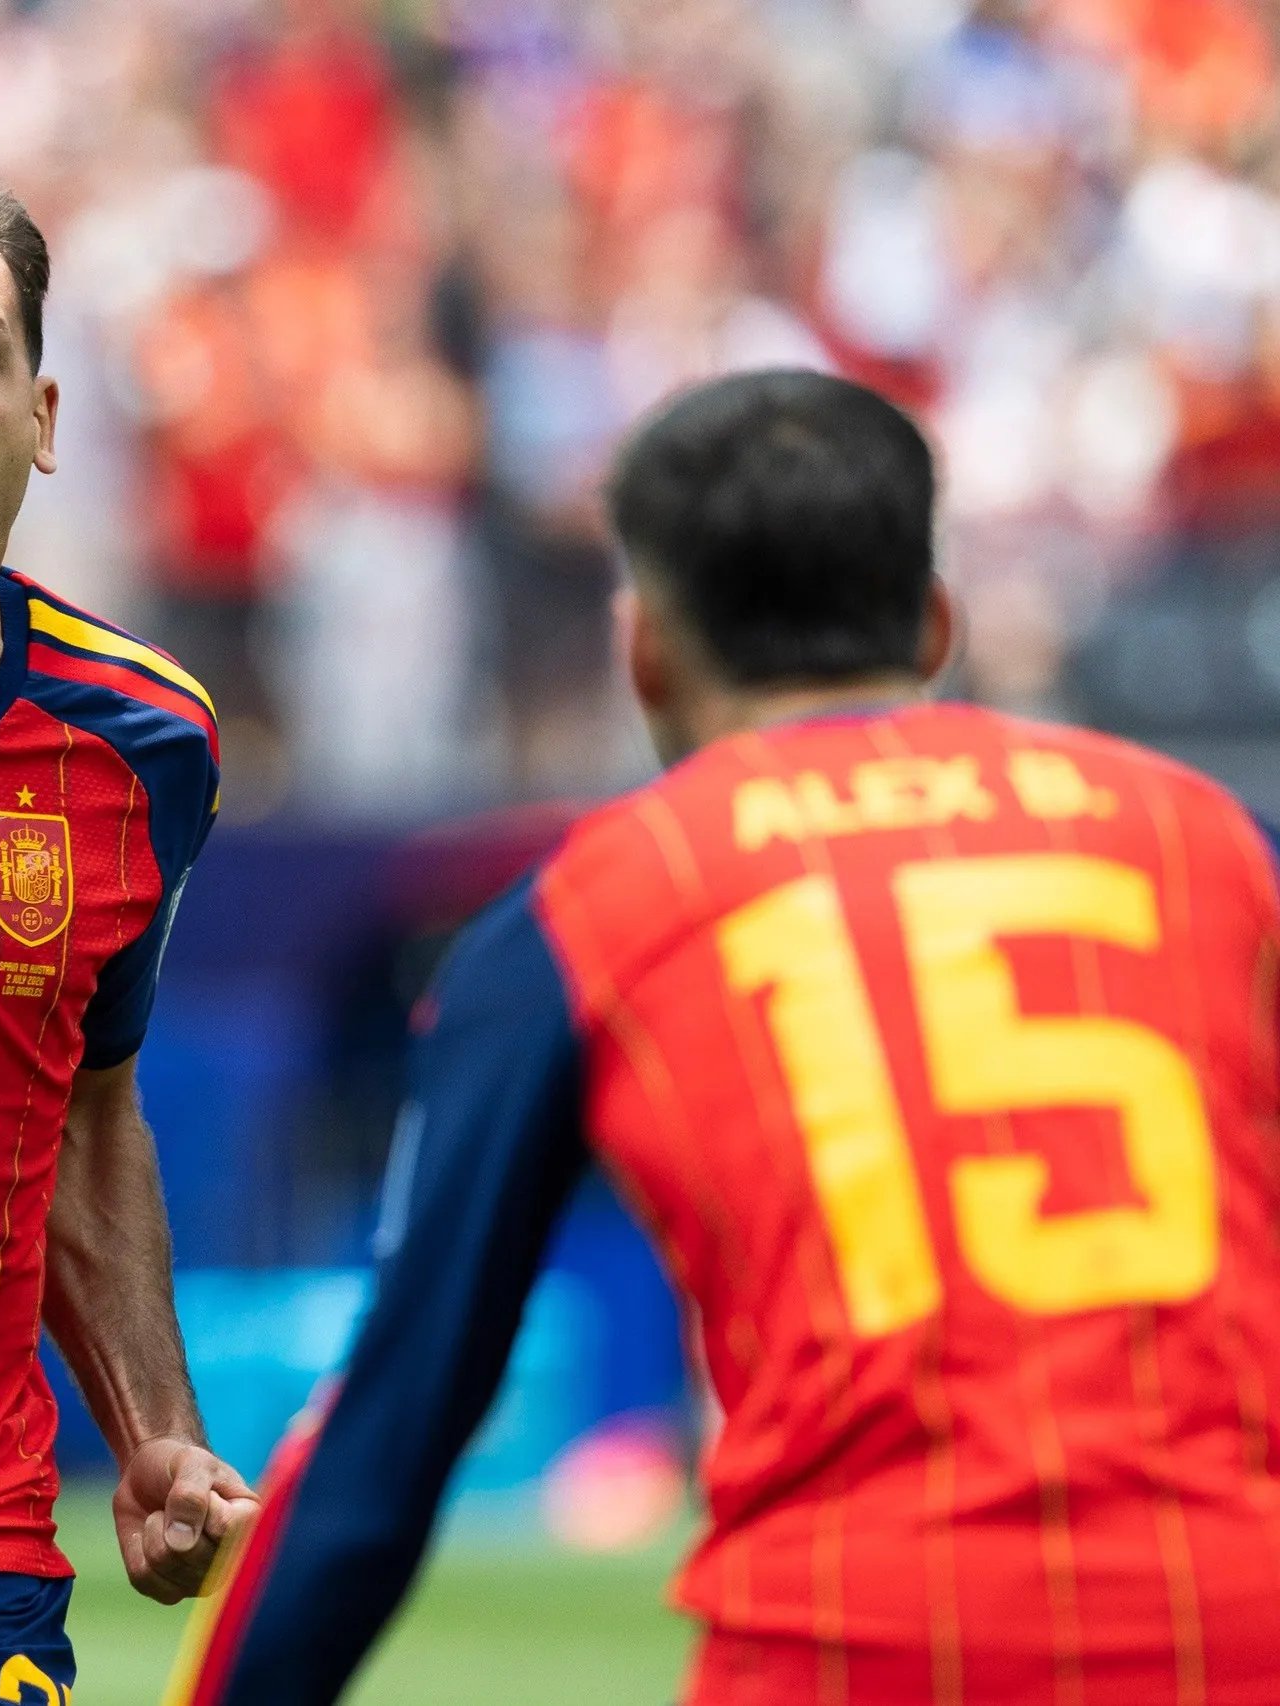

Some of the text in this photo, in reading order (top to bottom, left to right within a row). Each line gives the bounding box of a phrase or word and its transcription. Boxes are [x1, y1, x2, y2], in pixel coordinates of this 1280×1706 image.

[732, 754, 997, 852] ALEX
[6, 974, 12, 984] 2
[12, 974, 27, 984] JULY
[718, 852, 1221, 1339] 15
